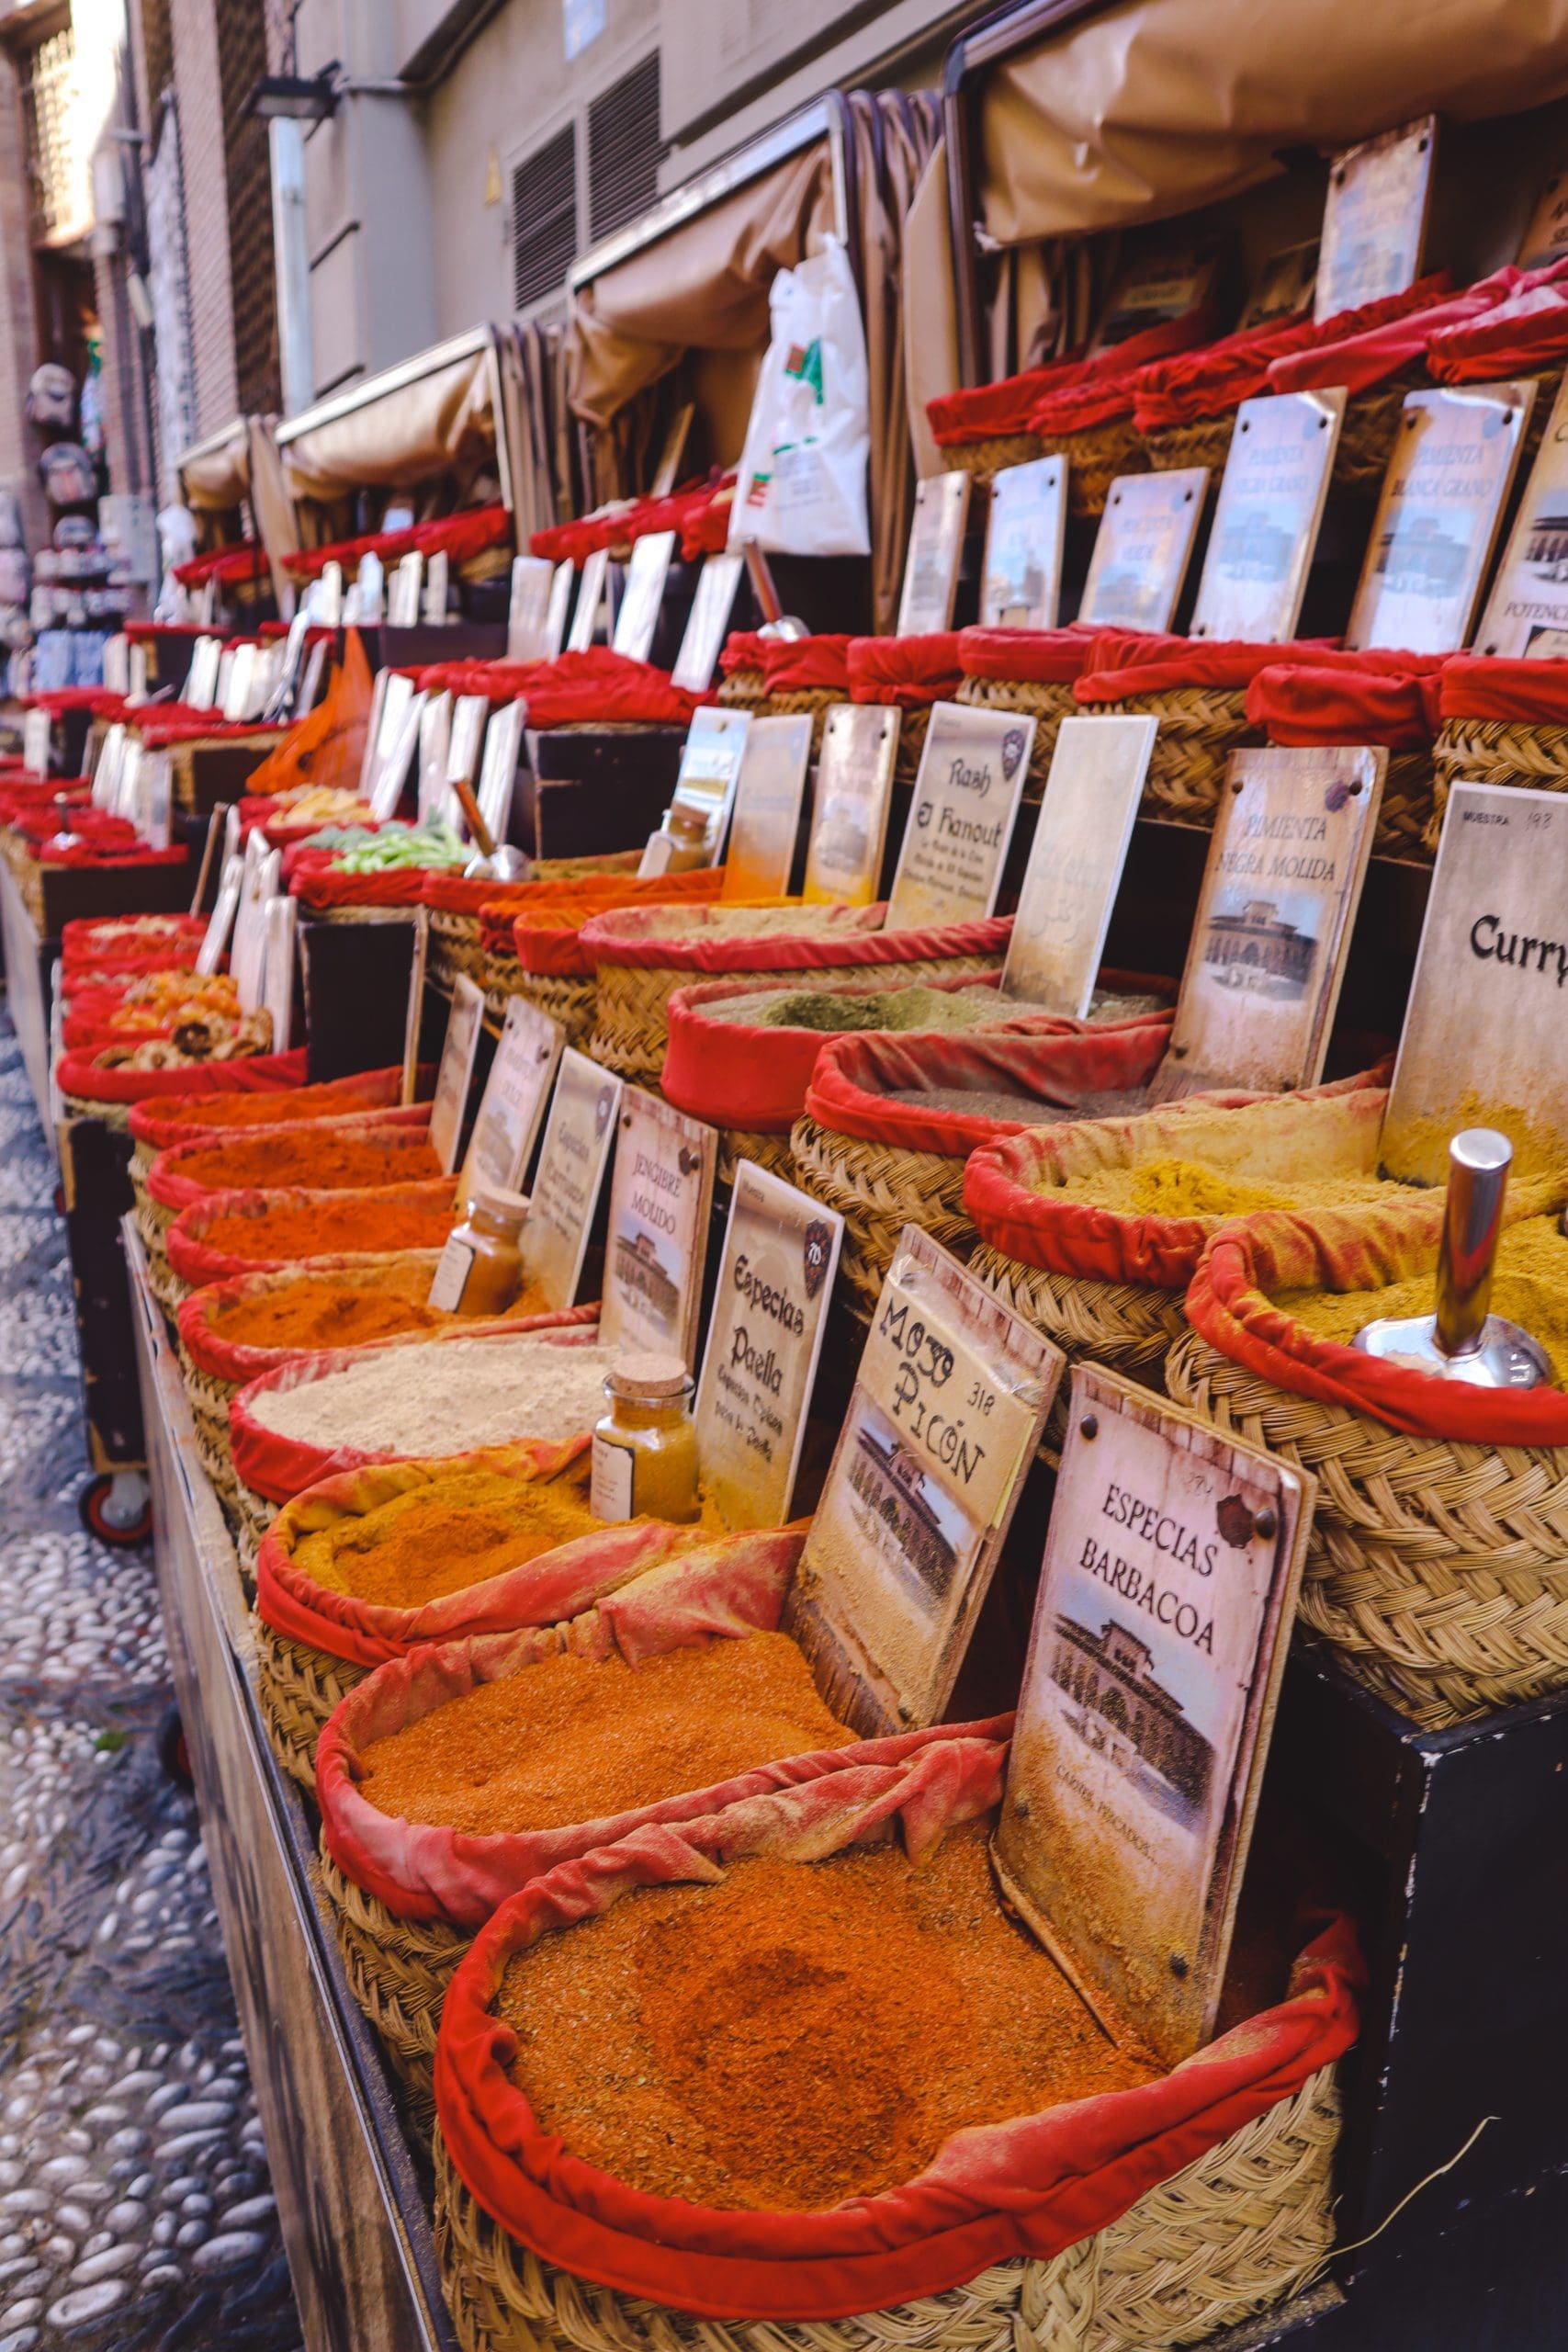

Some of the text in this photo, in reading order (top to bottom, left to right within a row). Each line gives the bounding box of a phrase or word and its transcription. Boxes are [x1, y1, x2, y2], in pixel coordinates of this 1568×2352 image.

[1243, 813, 1327, 842] PIMIENTA
[1214, 851, 1336, 882] NEGRA MOLIDA
[1470, 913, 1568, 989] Curry
[631, 1191, 676, 1236] MOLIDO
[734, 1254, 805, 1339] Especias
[730, 1326, 784, 1397] Paella
[966, 1381, 996, 1417] 318
[1101, 1483, 1219, 1577] ESPECIAS
[1078, 1537, 1215, 1656] BARBACOA
